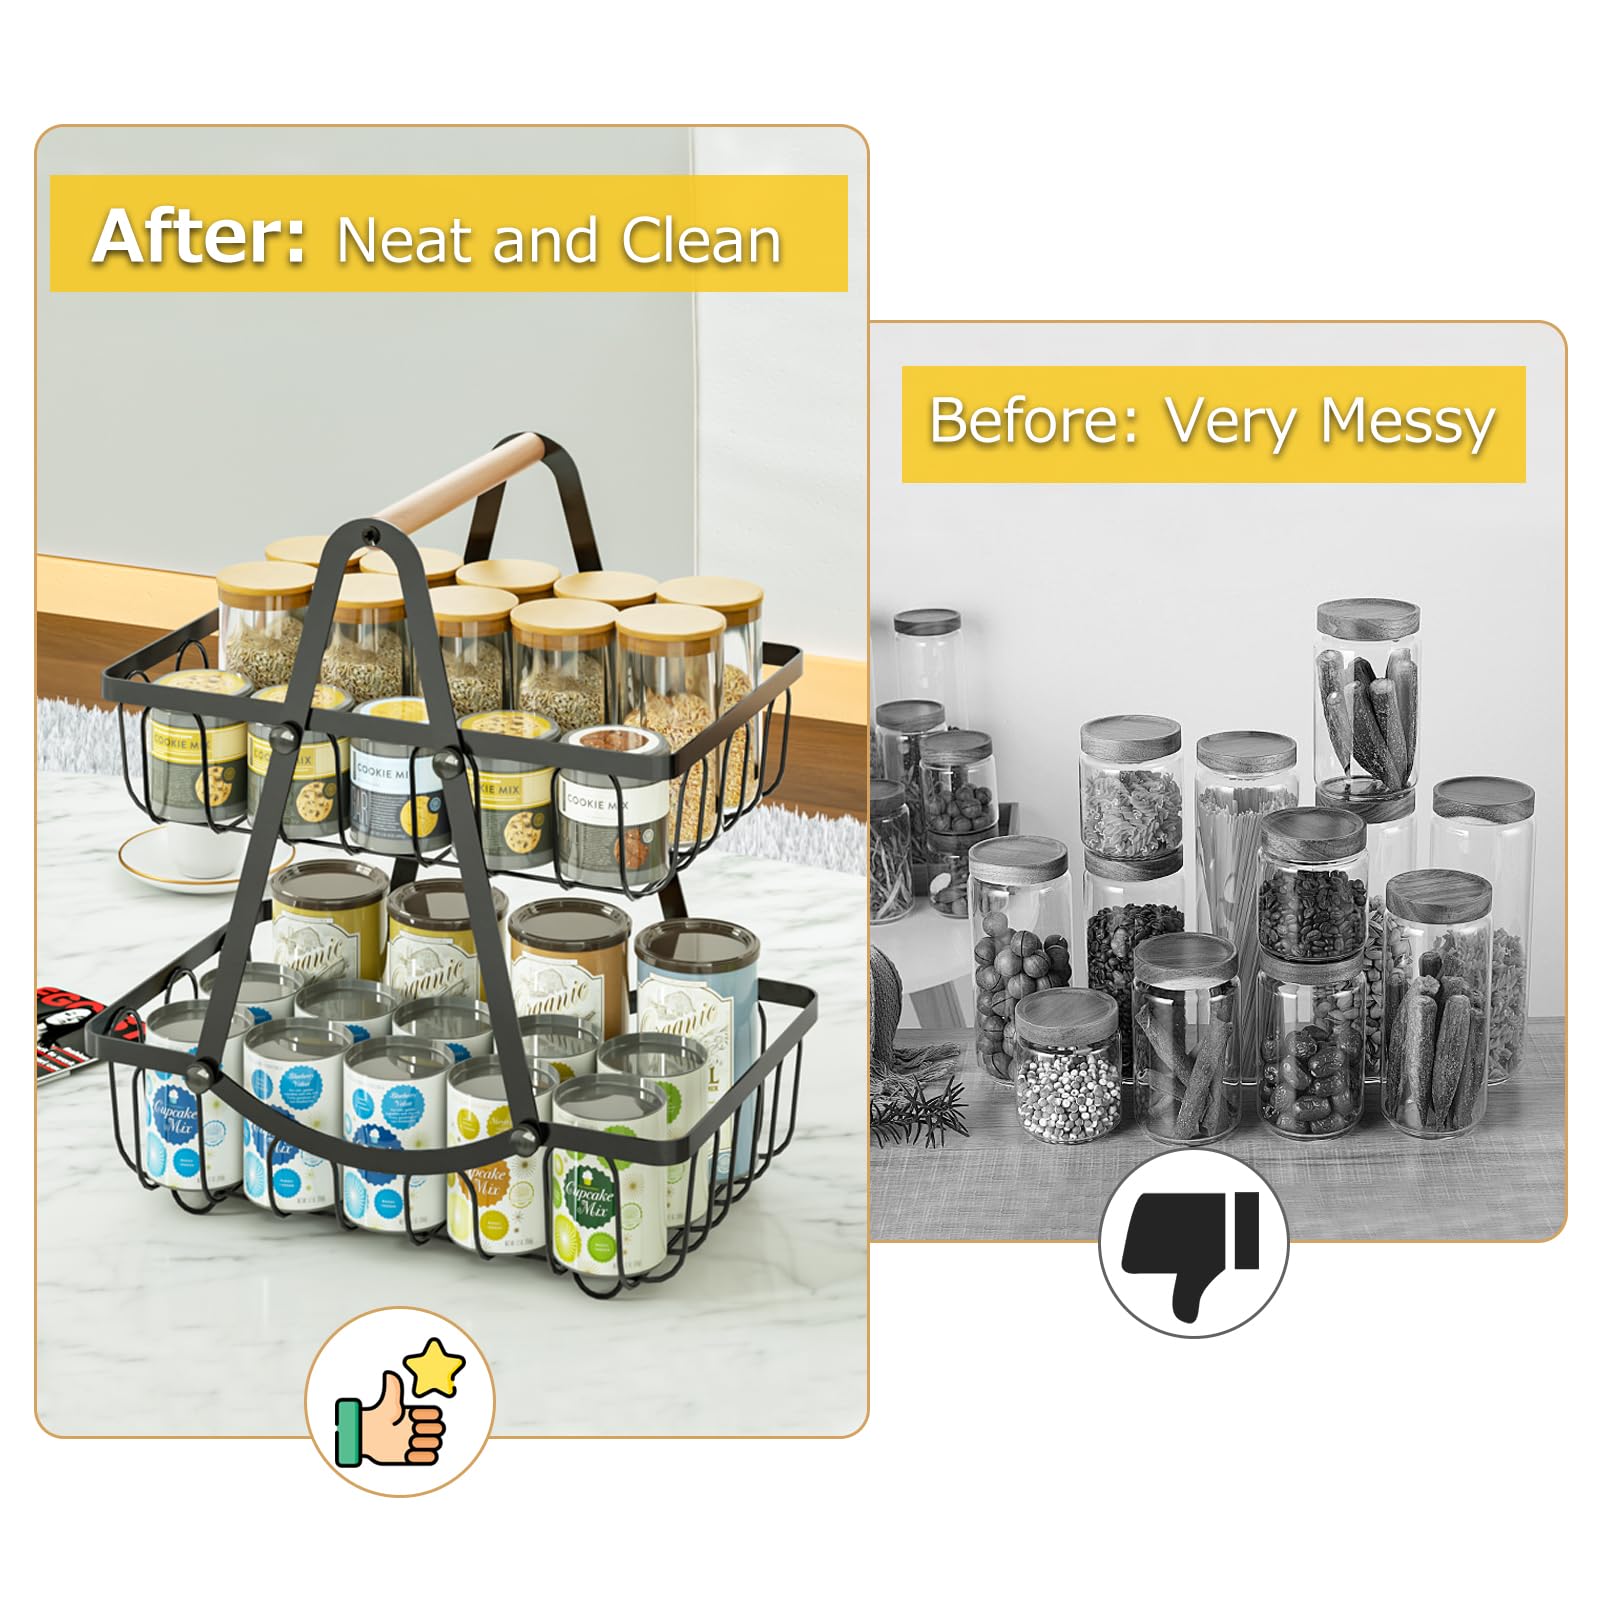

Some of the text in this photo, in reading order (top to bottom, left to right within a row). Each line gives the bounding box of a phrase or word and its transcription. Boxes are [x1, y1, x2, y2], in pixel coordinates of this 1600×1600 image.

[154, 734, 186, 749] COOKIE
[357, 763, 410, 779] COOKIE MI
[479, 783, 520, 795] KIE MIX
[567, 794, 630, 810] COOKIE MX
[153, 1099, 198, 1120] Cupcake
[165, 1118, 193, 1134] Mix
[470, 1167, 506, 1180] pcake
[565, 1180, 615, 1202] Cupcake
[577, 1199, 609, 1217] Mix
